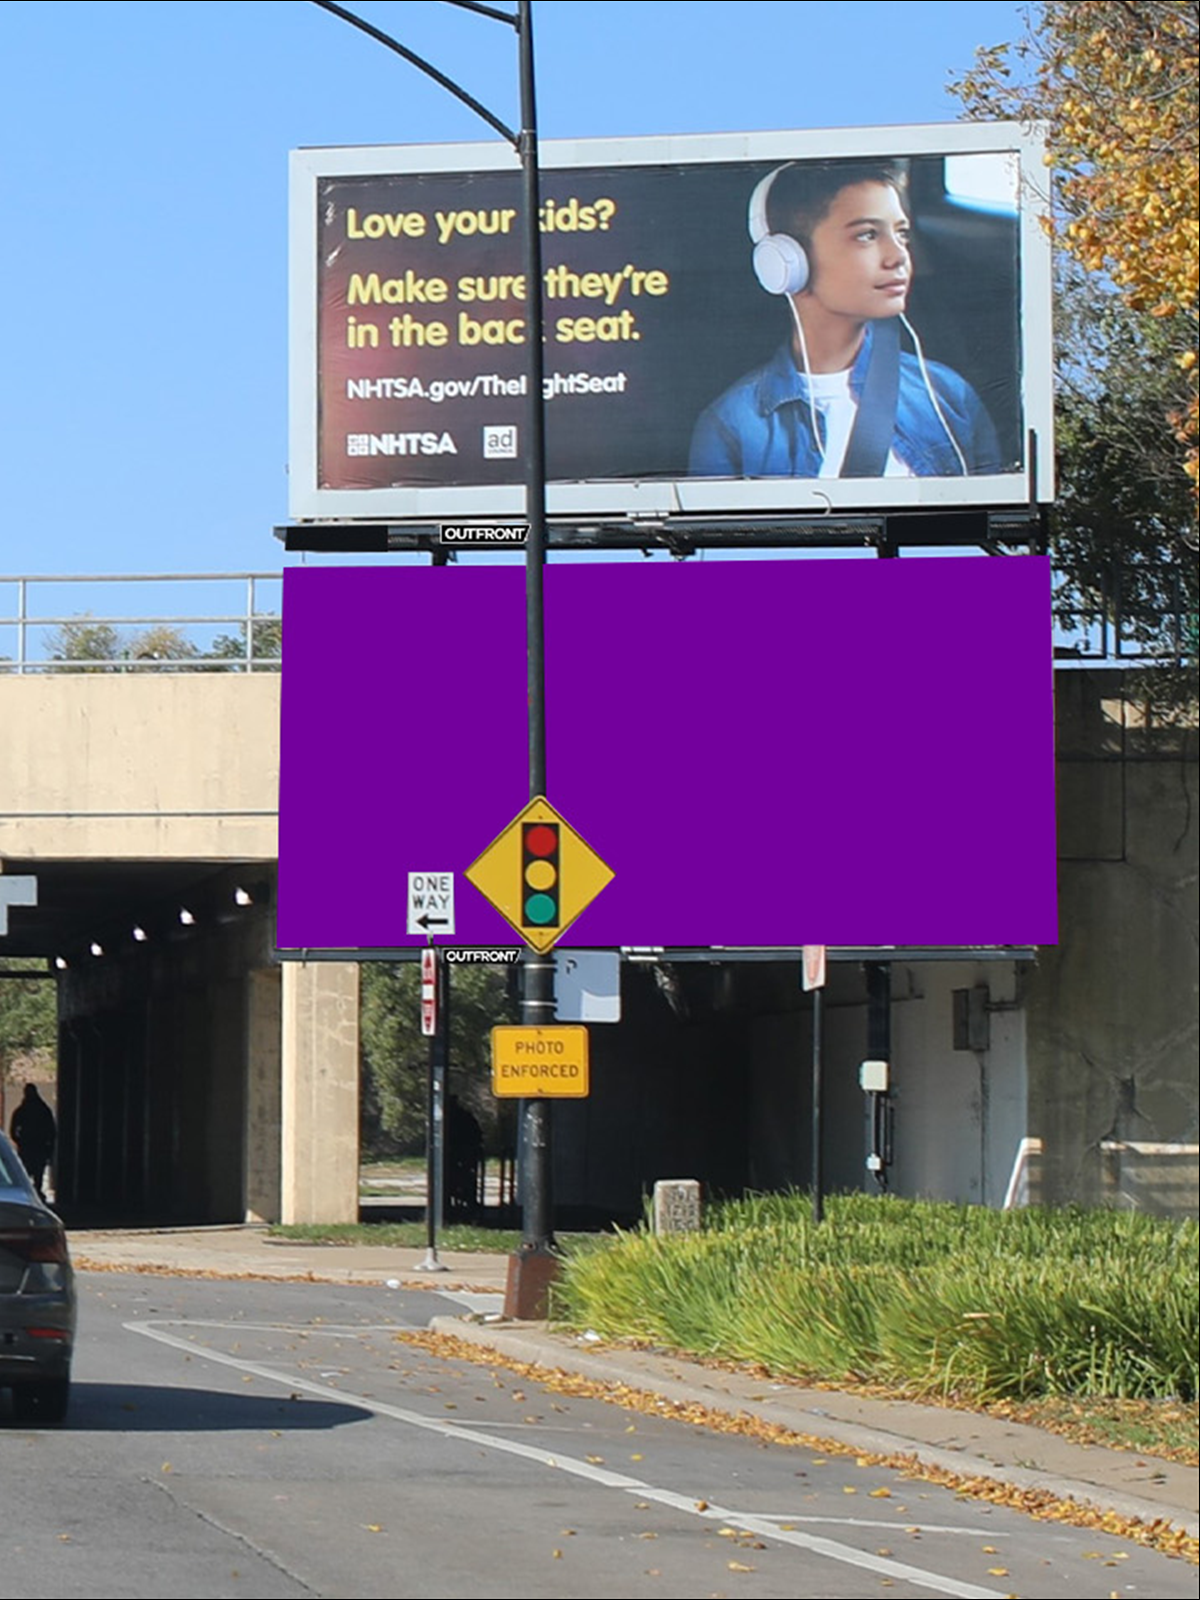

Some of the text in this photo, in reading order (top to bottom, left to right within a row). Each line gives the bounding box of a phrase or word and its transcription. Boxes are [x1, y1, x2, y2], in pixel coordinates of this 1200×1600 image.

[347, 208, 425, 239] Love
[435, 208, 516, 244] your
[348, 270, 448, 305] Make
[457, 275, 526, 301] sure
[348, 310, 641, 348] in the bac seat.
[348, 371, 627, 402] NHTSA.gov/TheghtSeat
[370, 432, 458, 455] NHTSA
[488, 429, 513, 448] ad
[444, 527, 526, 540] OUTFRONT
[413, 876, 450, 891] ONE
[412, 895, 450, 909] WAY
[445, 951, 517, 963] OUTFRONT
[514, 1041, 565, 1055] PHOTO
[501, 1064, 579, 1078] ENFORCED
